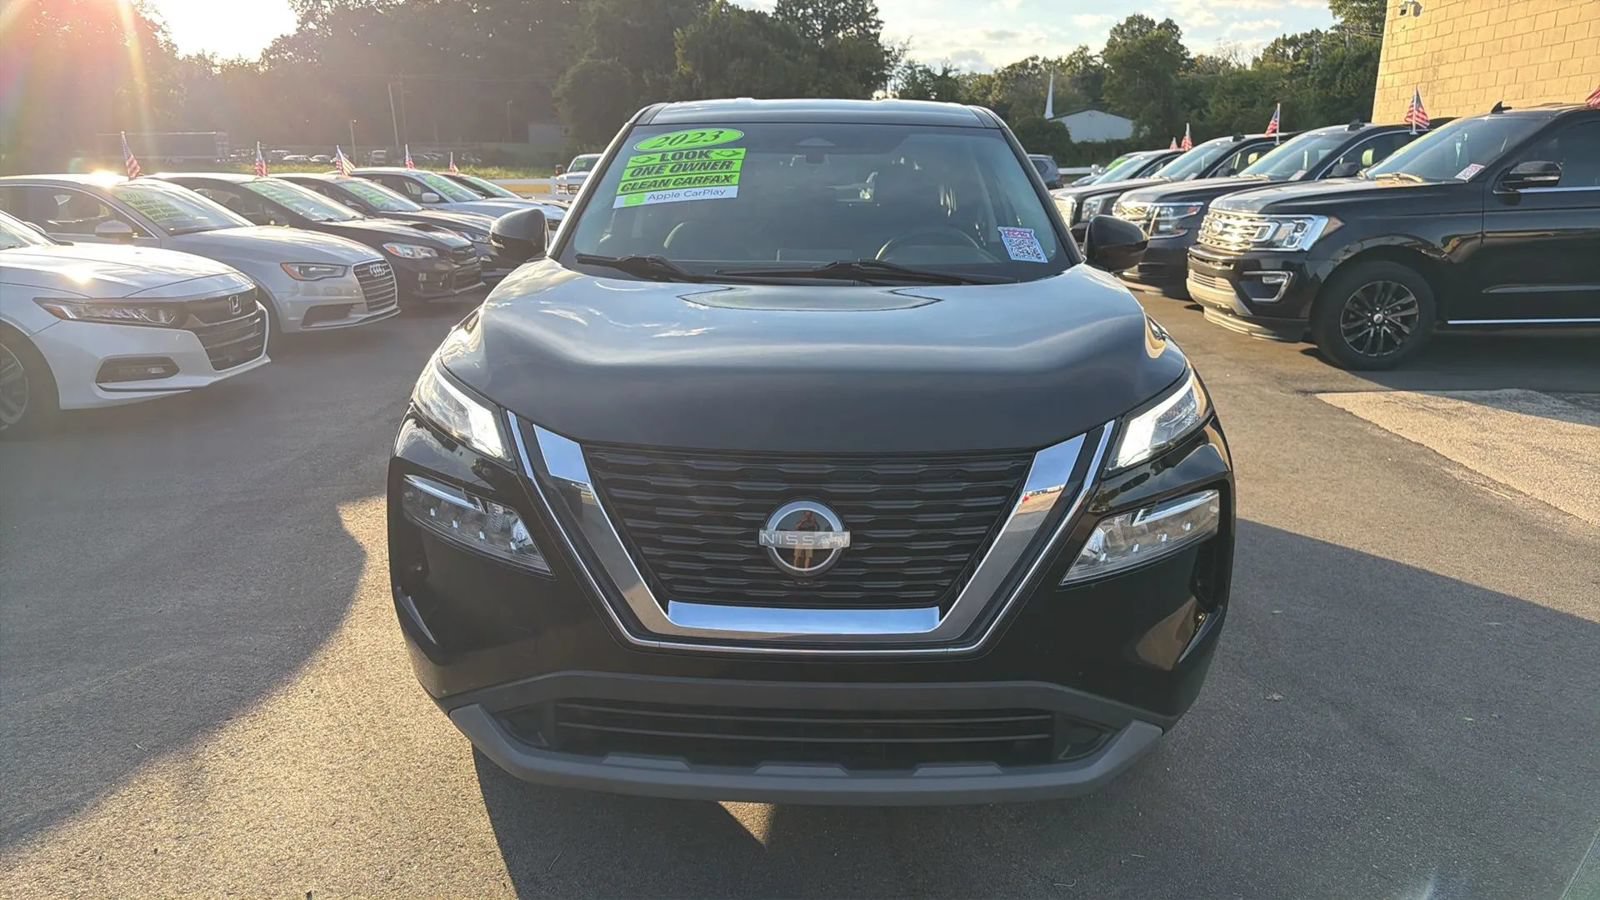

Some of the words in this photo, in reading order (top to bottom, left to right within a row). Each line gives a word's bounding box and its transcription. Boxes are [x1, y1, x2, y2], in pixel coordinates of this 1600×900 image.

[650, 130, 724, 148] 2023
[660, 150, 712, 162] LOOK
[630, 165, 668, 177] ONE
[670, 161, 734, 173] OWNER
[620, 179, 671, 192] CLEAN
[672, 175, 735, 187] CARFAX
[648, 192, 680, 201] Apple
[684, 189, 726, 198] CarPlay
